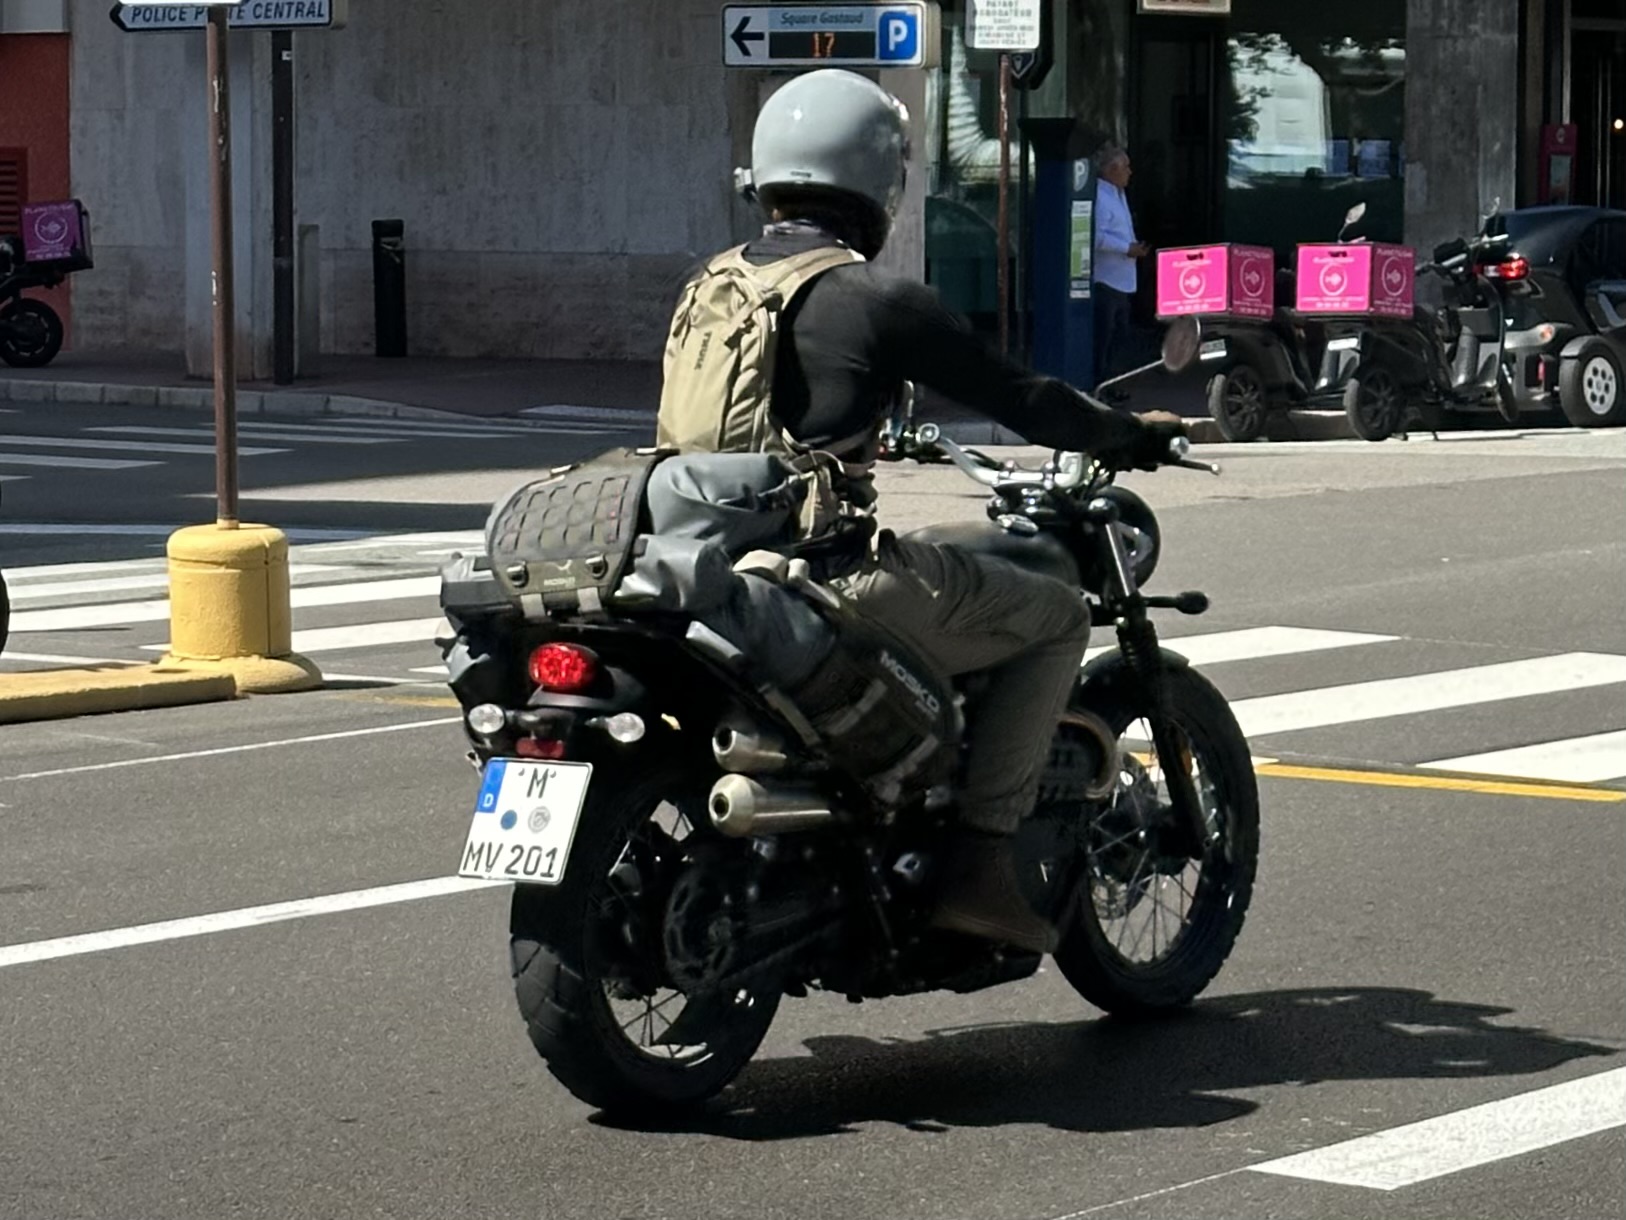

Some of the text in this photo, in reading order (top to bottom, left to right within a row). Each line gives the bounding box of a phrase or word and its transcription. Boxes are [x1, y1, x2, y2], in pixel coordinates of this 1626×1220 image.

[132, 1, 324, 22] POLICE PTE CENTRAL
[781, 12, 864, 26] Square Gastaud
[813, 33, 836, 58] 17
[888, 19, 908, 51] P
[527, 768, 549, 798] M
[482, 793, 494, 807] D
[463, 841, 558, 878] MV 201
